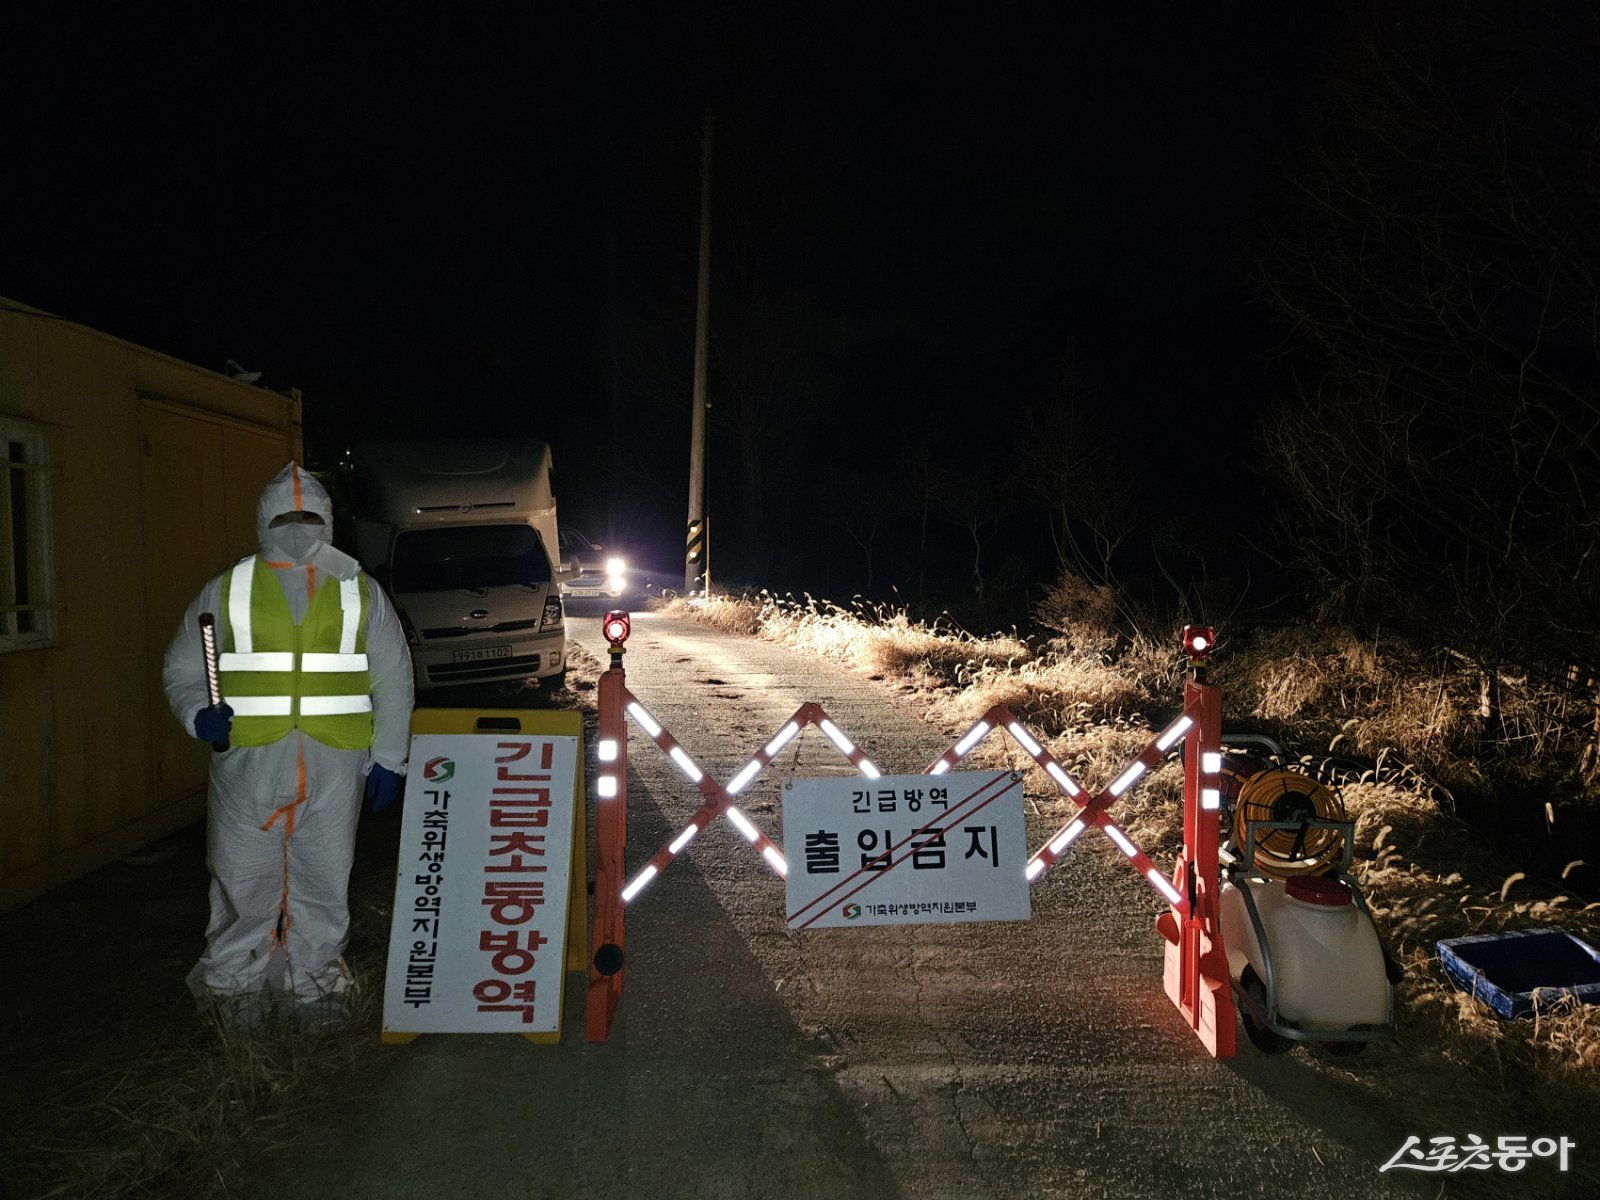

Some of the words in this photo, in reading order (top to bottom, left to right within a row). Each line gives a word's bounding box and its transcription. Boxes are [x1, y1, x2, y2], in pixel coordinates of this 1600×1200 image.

[851, 787, 949, 814] 긴급방역
[804, 825, 999, 874] 출입금지
[403, 790, 451, 1009] 가축위생방역지원본부
[472, 742, 556, 1024] 긴급초동방역
[866, 902, 977, 916] 가축위생방역지원본부
